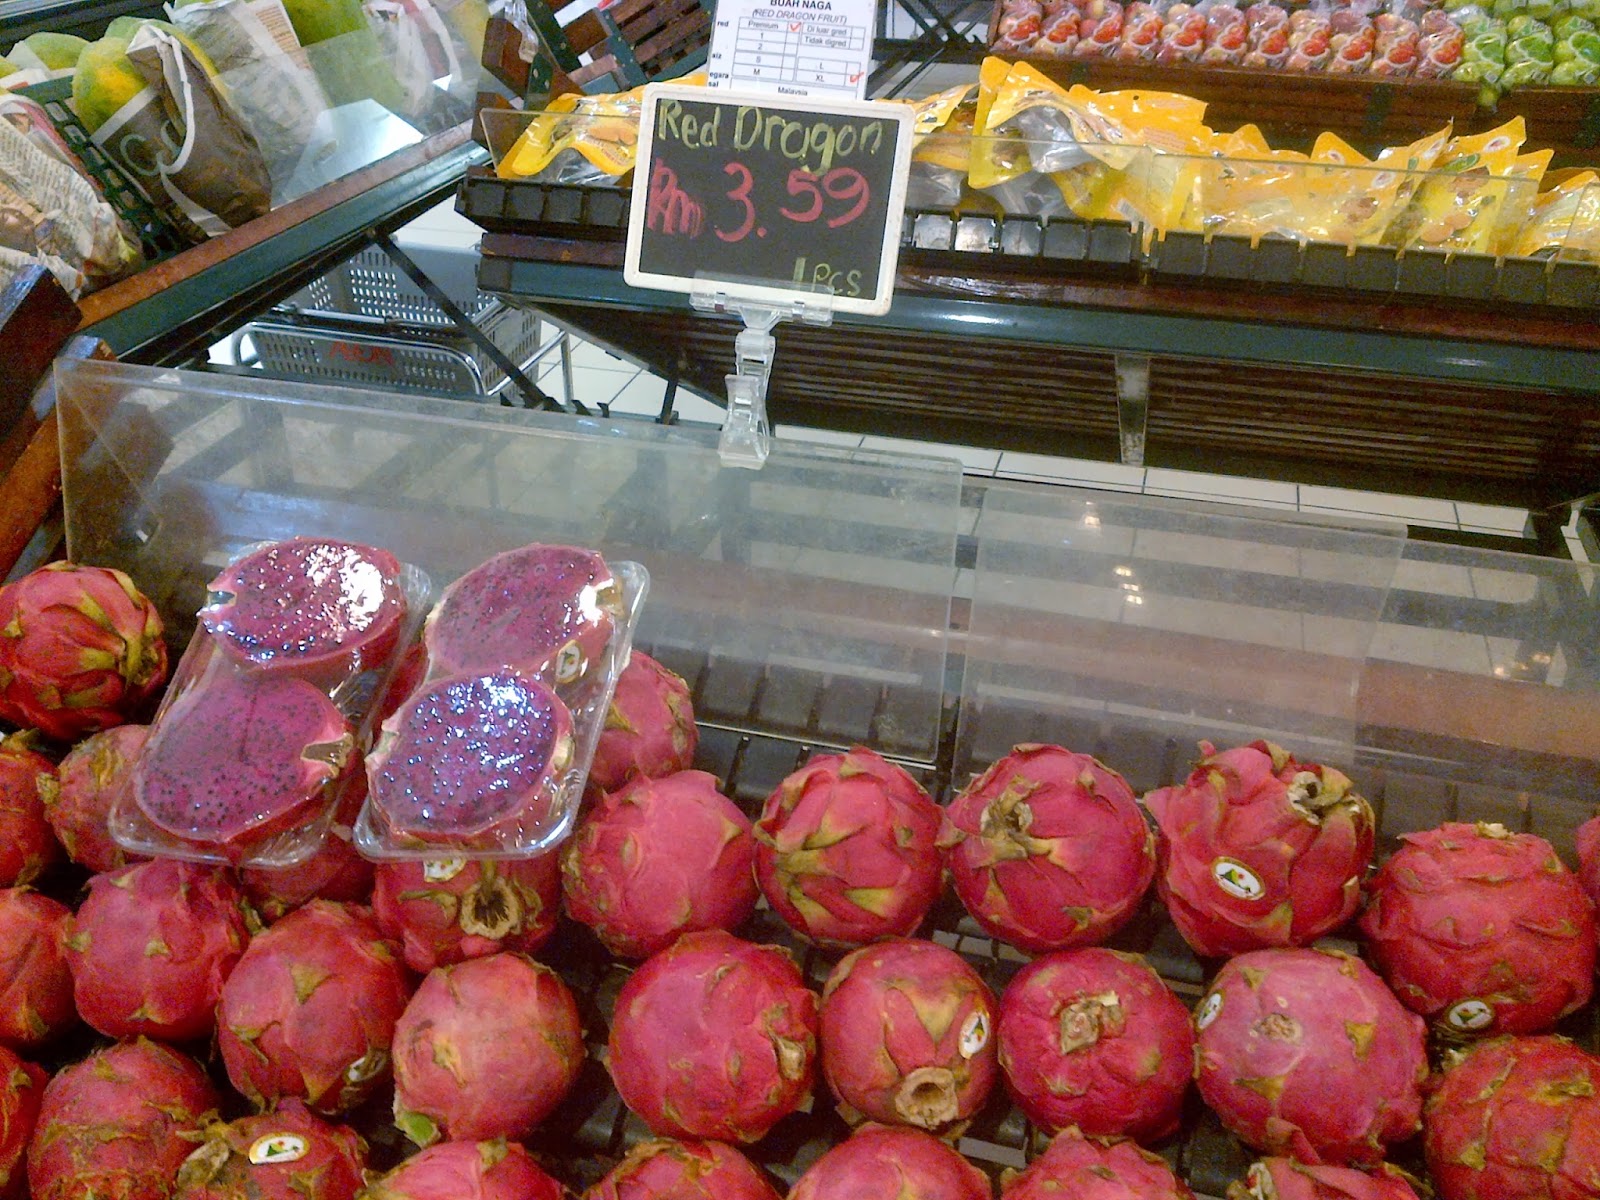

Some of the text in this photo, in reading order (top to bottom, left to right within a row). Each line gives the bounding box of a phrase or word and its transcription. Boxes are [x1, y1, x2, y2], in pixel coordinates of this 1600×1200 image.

[801, 0, 832, 11] NAGA
[752, 8, 848, 25] (RED DRAGON FRUIT)
[748, 20, 779, 29] Premium
[831, 28, 847, 37] gred
[804, 36, 823, 44] Tidak
[815, 74, 824, 83] XL
[658, 98, 883, 176] Red Dragon
